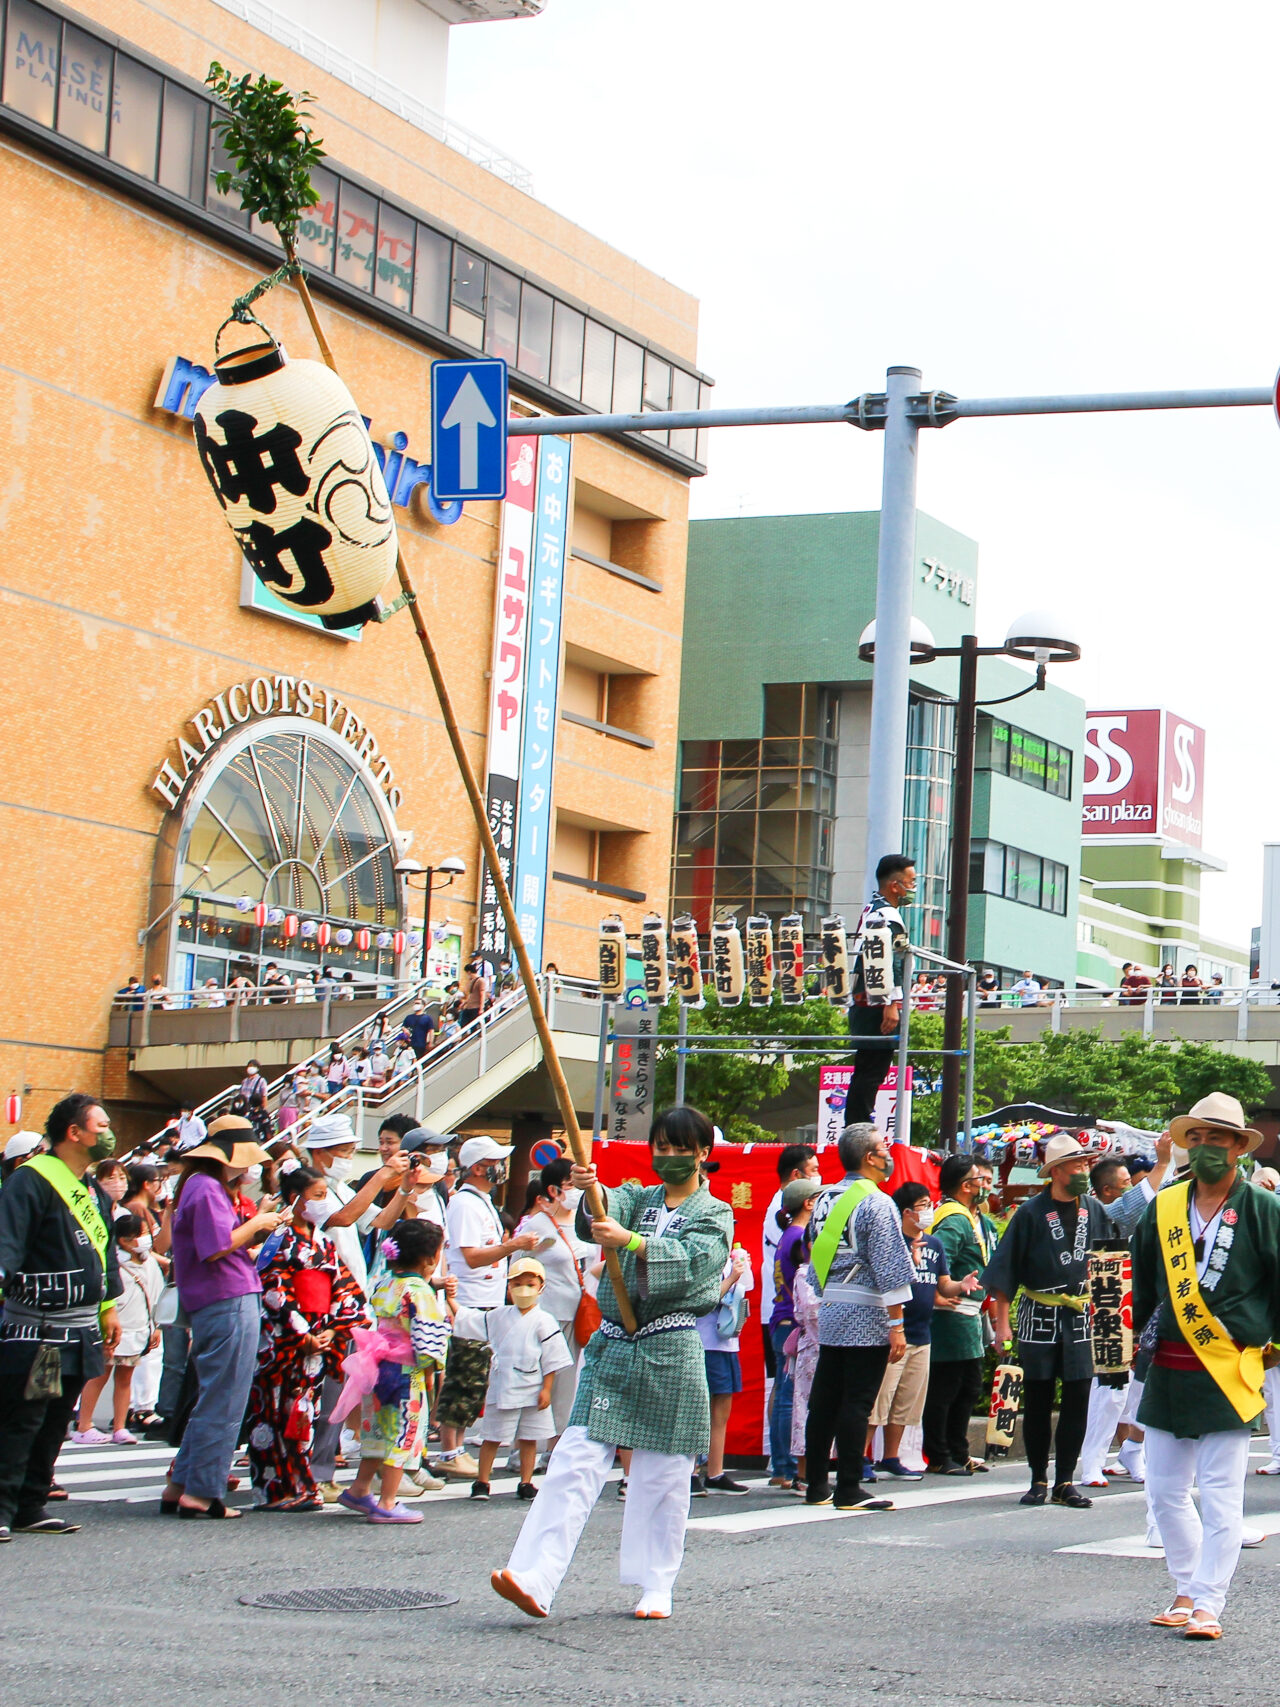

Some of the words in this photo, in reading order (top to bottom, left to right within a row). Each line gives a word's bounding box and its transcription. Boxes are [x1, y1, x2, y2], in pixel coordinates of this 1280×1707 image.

[16, 56, 121, 123] PLAINUM
[497, 547, 527, 731] ユザワヤ
[520, 452, 563, 968] お中元ギフトセンター開設
[152, 675, 405, 814] HARICOTS-VERTS
[1111, 799, 1153, 824] plaza
[713, 936, 732, 993] 宮本町
[822, 933, 844, 995] 本町
[863, 936, 886, 990] 柏座
[643, 1208, 658, 1223] 若
[1090, 1260, 1120, 1276] 仲町
[1167, 1226, 1219, 1346] 仲町若衆頭
[594, 1396, 610, 1410] 29
[995, 1373, 1022, 1438] 仲町
